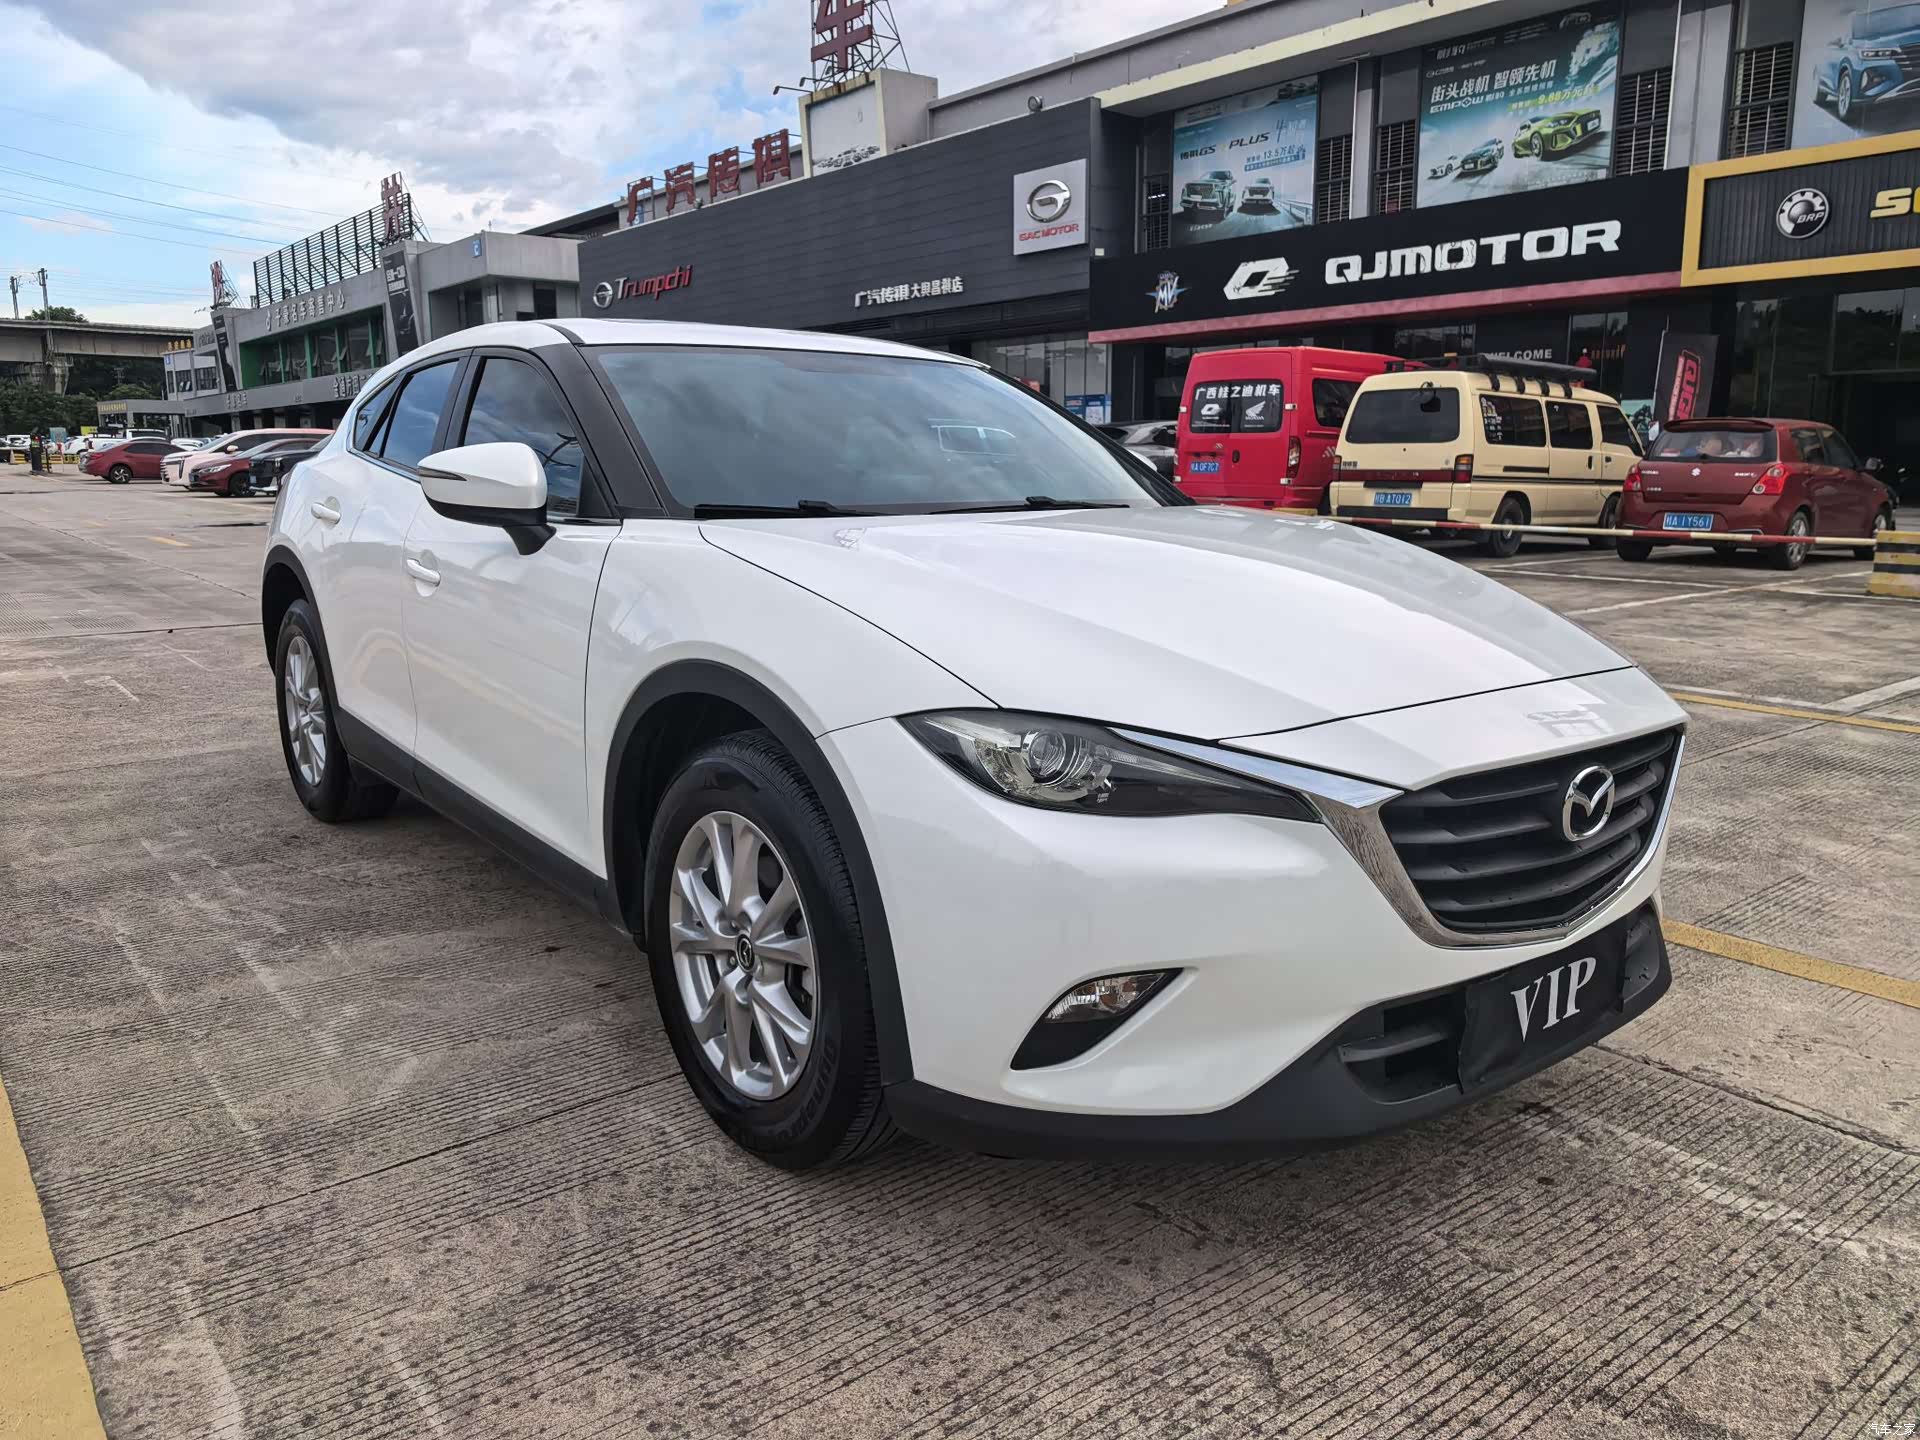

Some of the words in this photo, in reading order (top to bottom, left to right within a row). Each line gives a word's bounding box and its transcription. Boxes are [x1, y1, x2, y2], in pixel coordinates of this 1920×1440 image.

[1431, 75, 1489, 103] 街头战机
[1494, 59, 1557, 90] 智领先机
[1429, 95, 1484, 114] EMPOW
[1229, 132, 1270, 149] PLUS
[627, 128, 792, 224] 广汽传祺
[1797, 211, 1825, 223] BRP
[1870, 187, 1920, 218] S
[1041, 223, 1080, 237] MOTOR
[1325, 219, 1621, 285] QJMOTOR
[615, 265, 692, 300] Trumpchi
[1194, 384, 1281, 400] 广西桂之迪机车
[1510, 957, 1597, 1042] VIP
